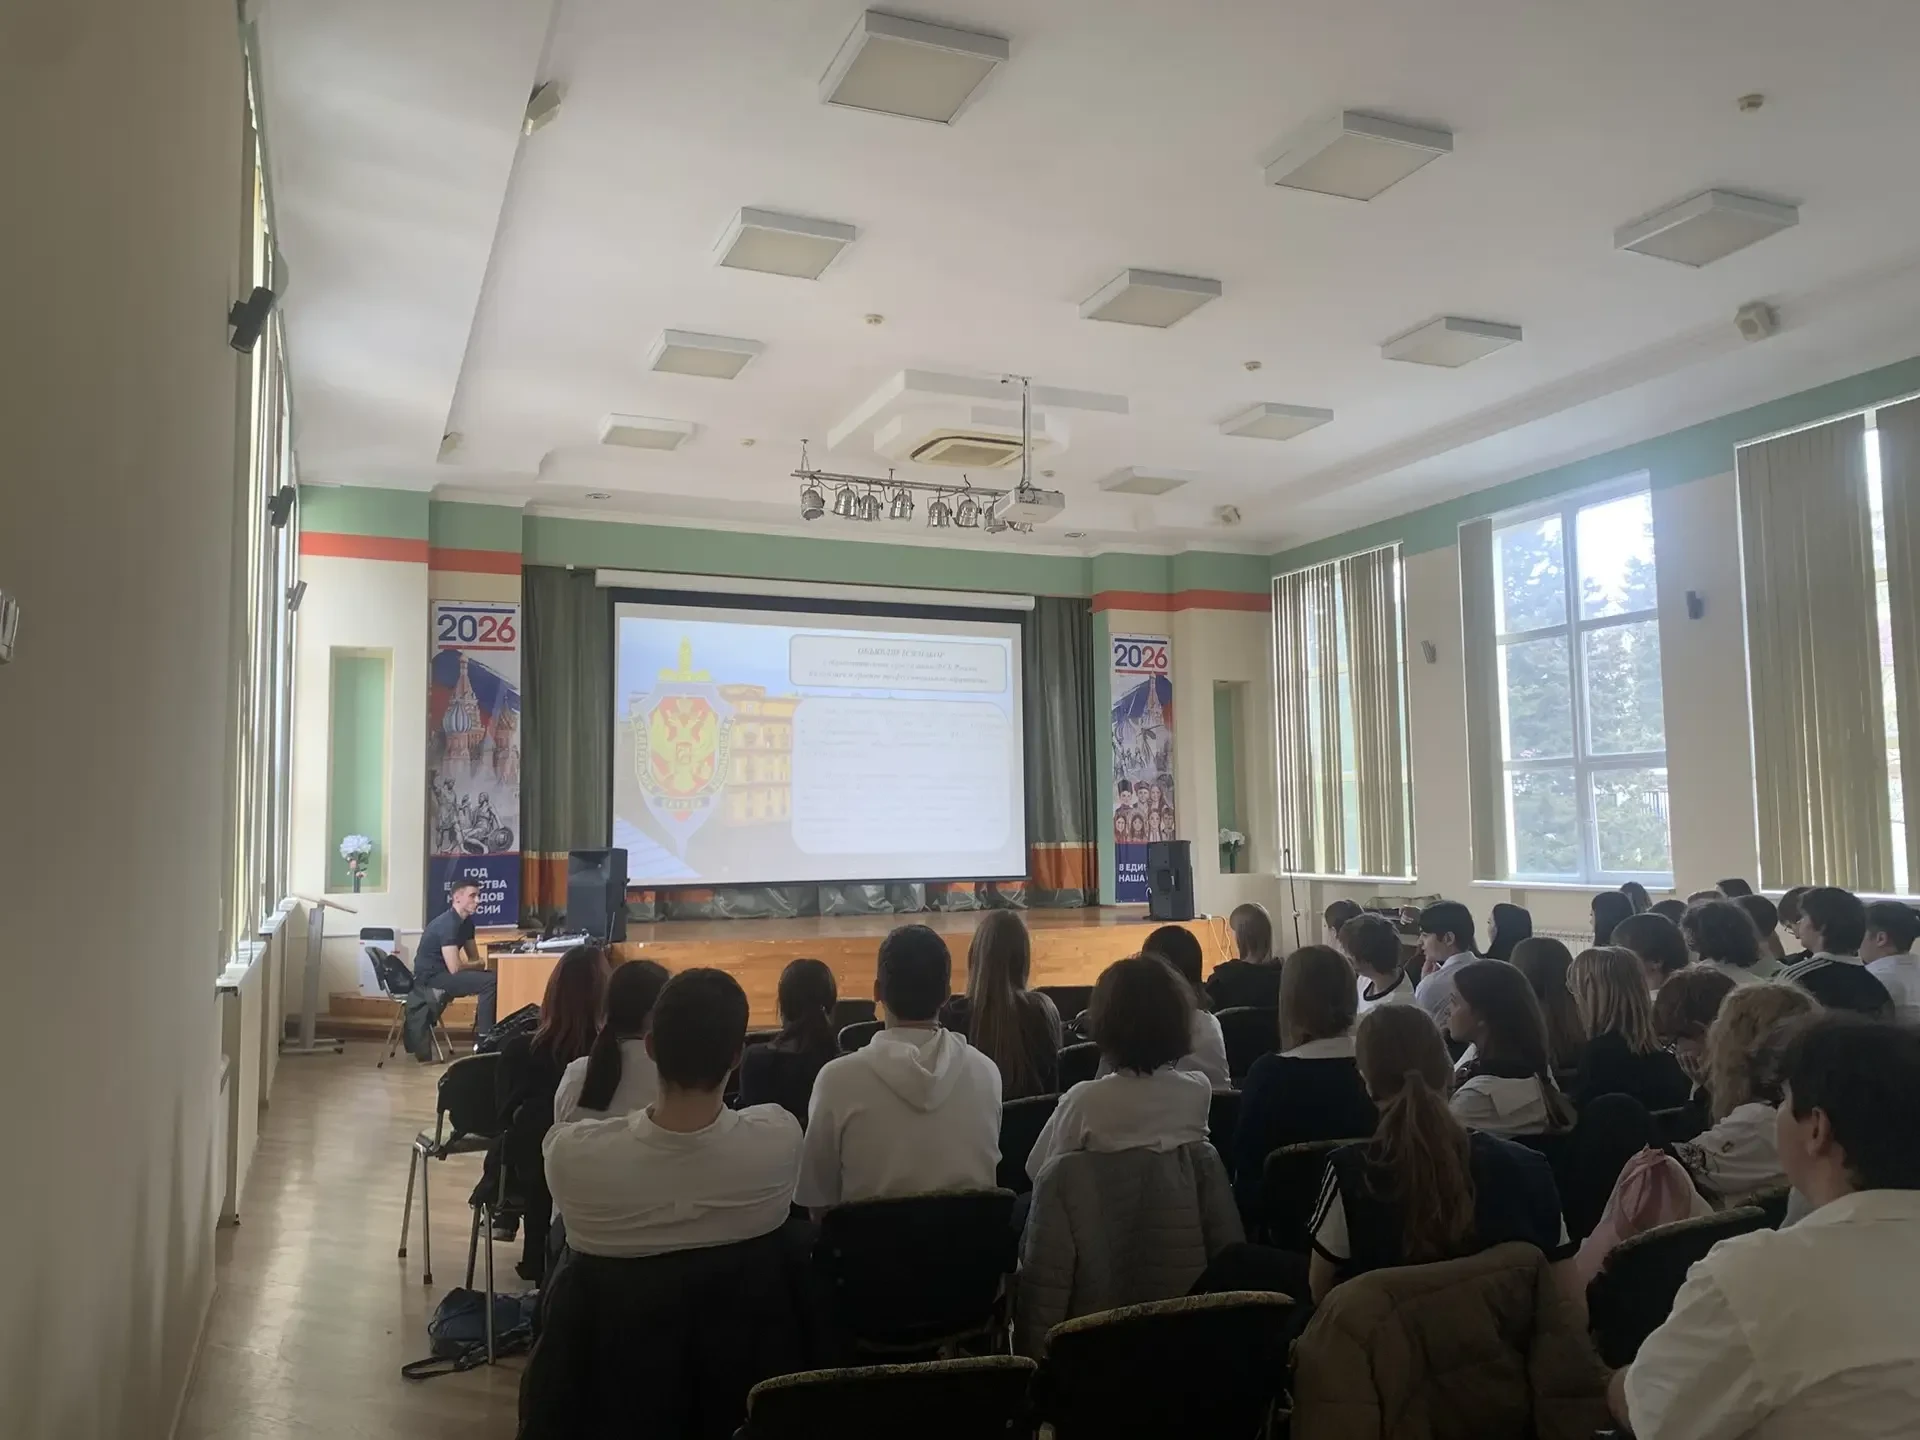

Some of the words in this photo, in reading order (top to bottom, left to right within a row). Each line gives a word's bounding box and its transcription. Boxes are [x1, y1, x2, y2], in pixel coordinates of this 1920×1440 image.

[438, 614, 516, 643] 2026
[1114, 644, 1168, 669] 2026
[1119, 863, 1124, 871] В
[463, 868, 488, 878] ГОД
[1118, 874, 1146, 883] НАША
[443, 880, 508, 891] ЕСТВА
